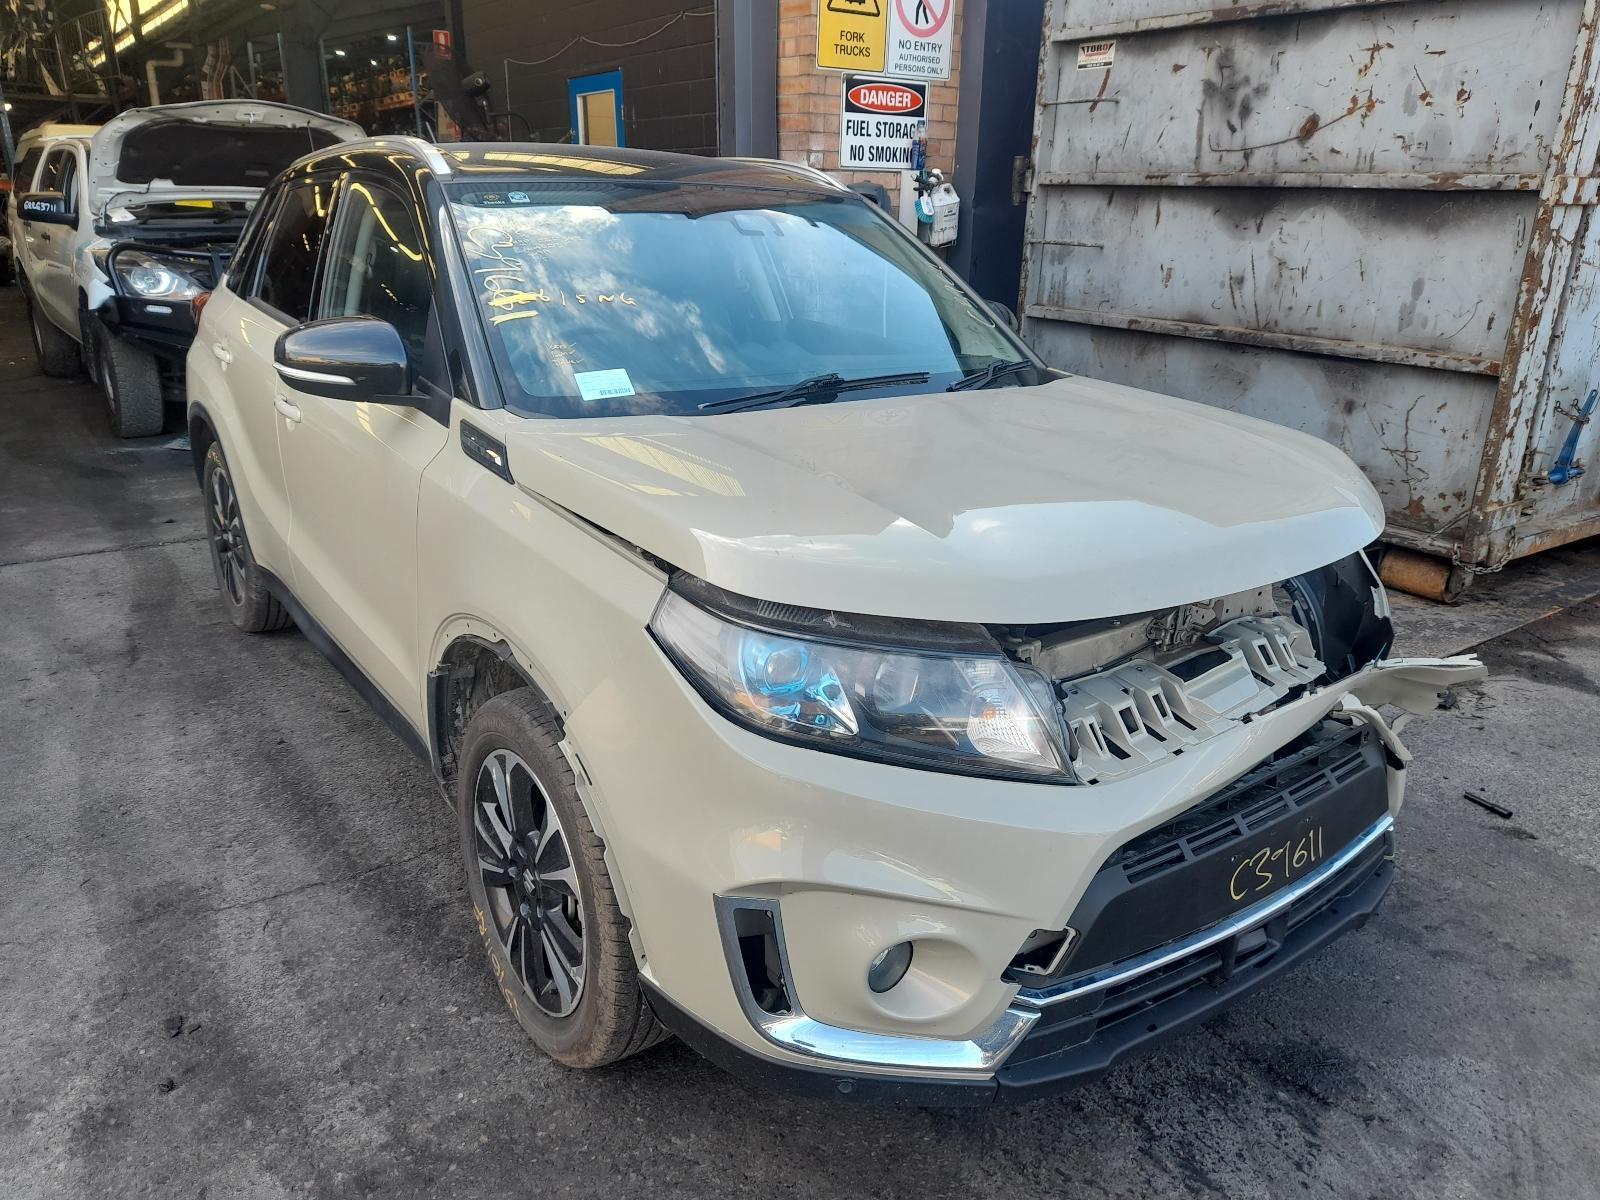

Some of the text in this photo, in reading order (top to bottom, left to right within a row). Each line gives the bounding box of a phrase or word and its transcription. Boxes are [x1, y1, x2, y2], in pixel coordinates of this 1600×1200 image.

[840, 30, 865, 43] FORK
[834, 44, 870, 57] TRUCKS
[899, 39, 942, 53] NO ENTRY
[899, 53, 941, 65] AUTHORISED
[895, 63, 943, 75] PERSONS ONLY
[860, 88, 912, 108] DANGER
[846, 119, 872, 137] FUEL
[849, 144, 865, 162] NO
[1230, 826, 1323, 900] C39611
